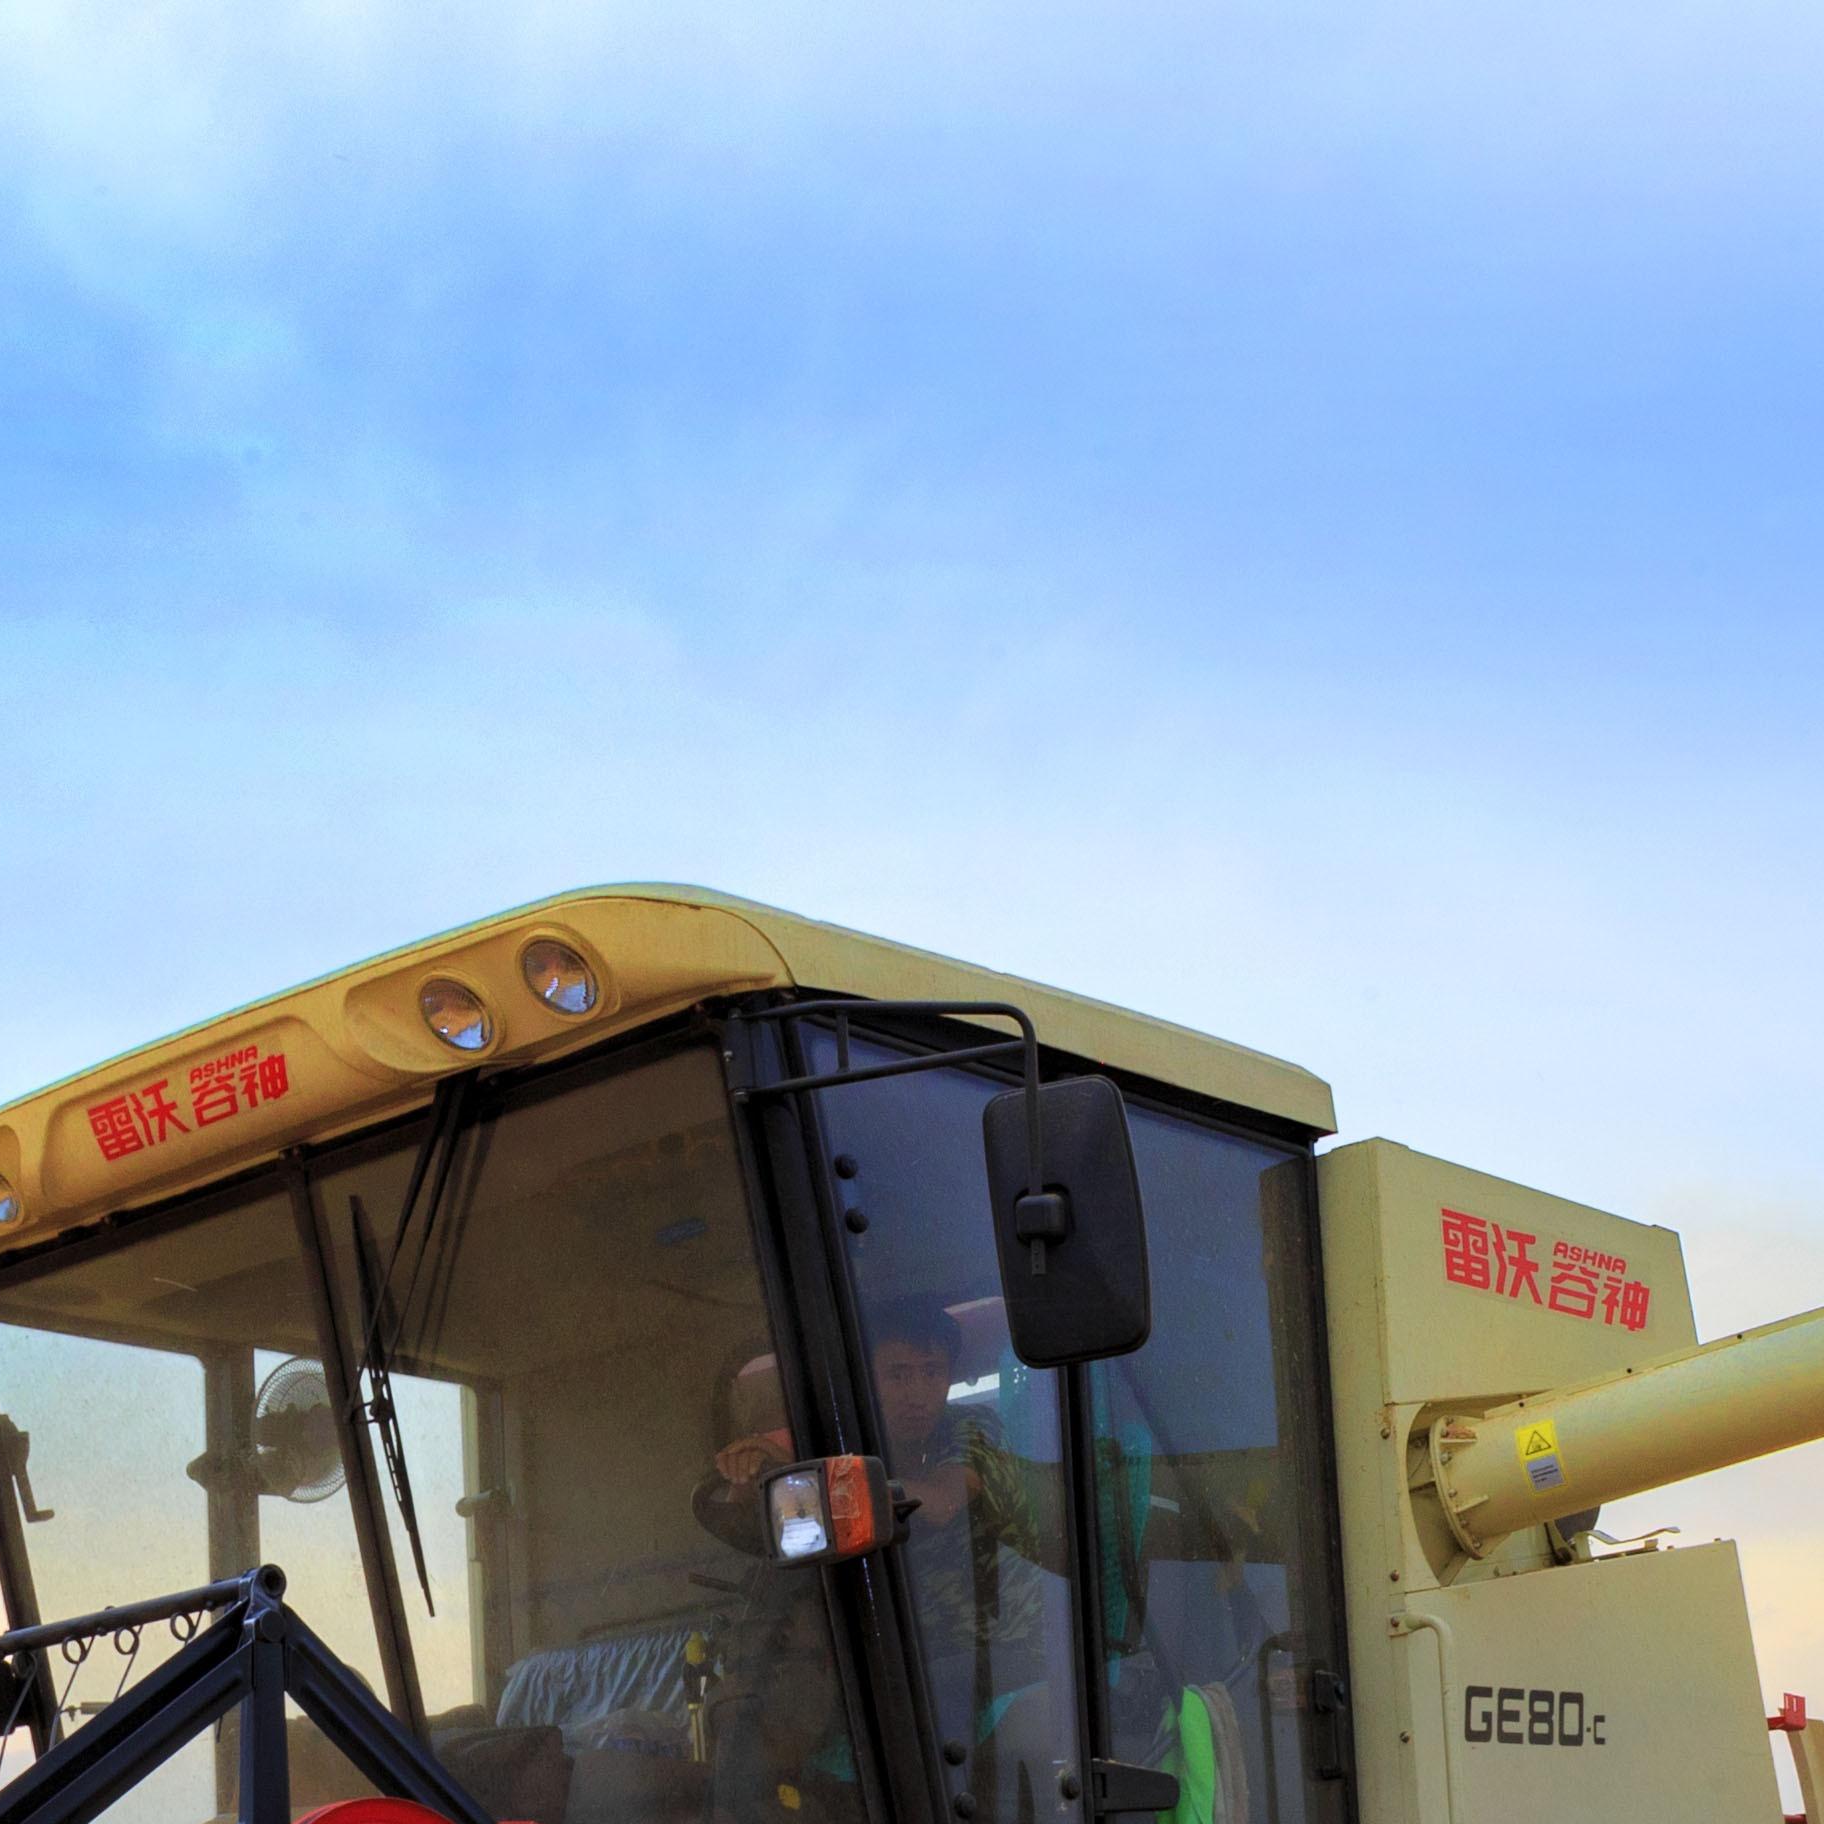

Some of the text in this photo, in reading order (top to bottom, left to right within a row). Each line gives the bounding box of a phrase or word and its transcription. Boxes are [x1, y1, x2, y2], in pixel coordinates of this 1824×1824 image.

[190, 1045, 258, 1084] ASHNA
[87, 1053, 289, 1161] 雷沃谷神
[1441, 1208, 1650, 1331] 雷沃谷神
[1553, 1241, 1627, 1275] ASHNA
